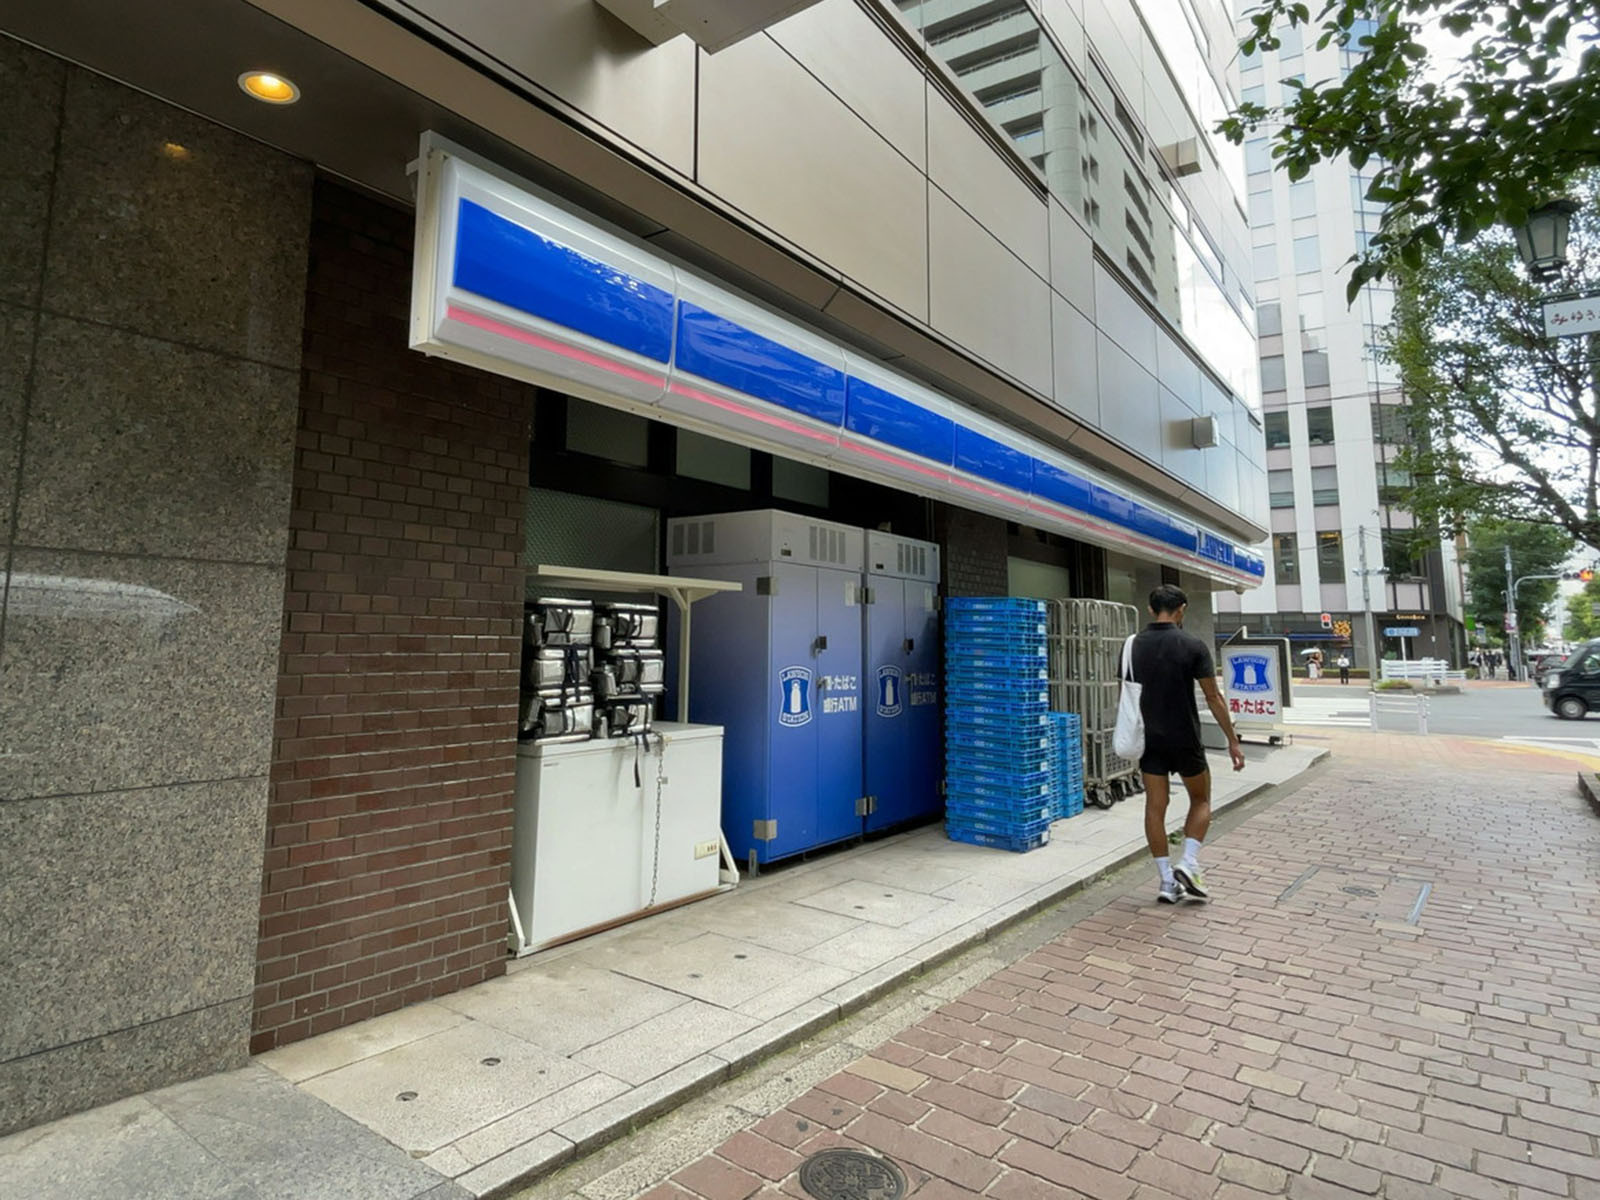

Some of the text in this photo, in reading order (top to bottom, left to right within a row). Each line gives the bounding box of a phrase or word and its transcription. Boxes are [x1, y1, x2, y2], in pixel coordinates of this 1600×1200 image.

[1550, 309, 1600, 326] みゆき
[1231, 656, 1267, 665] LAWSON
